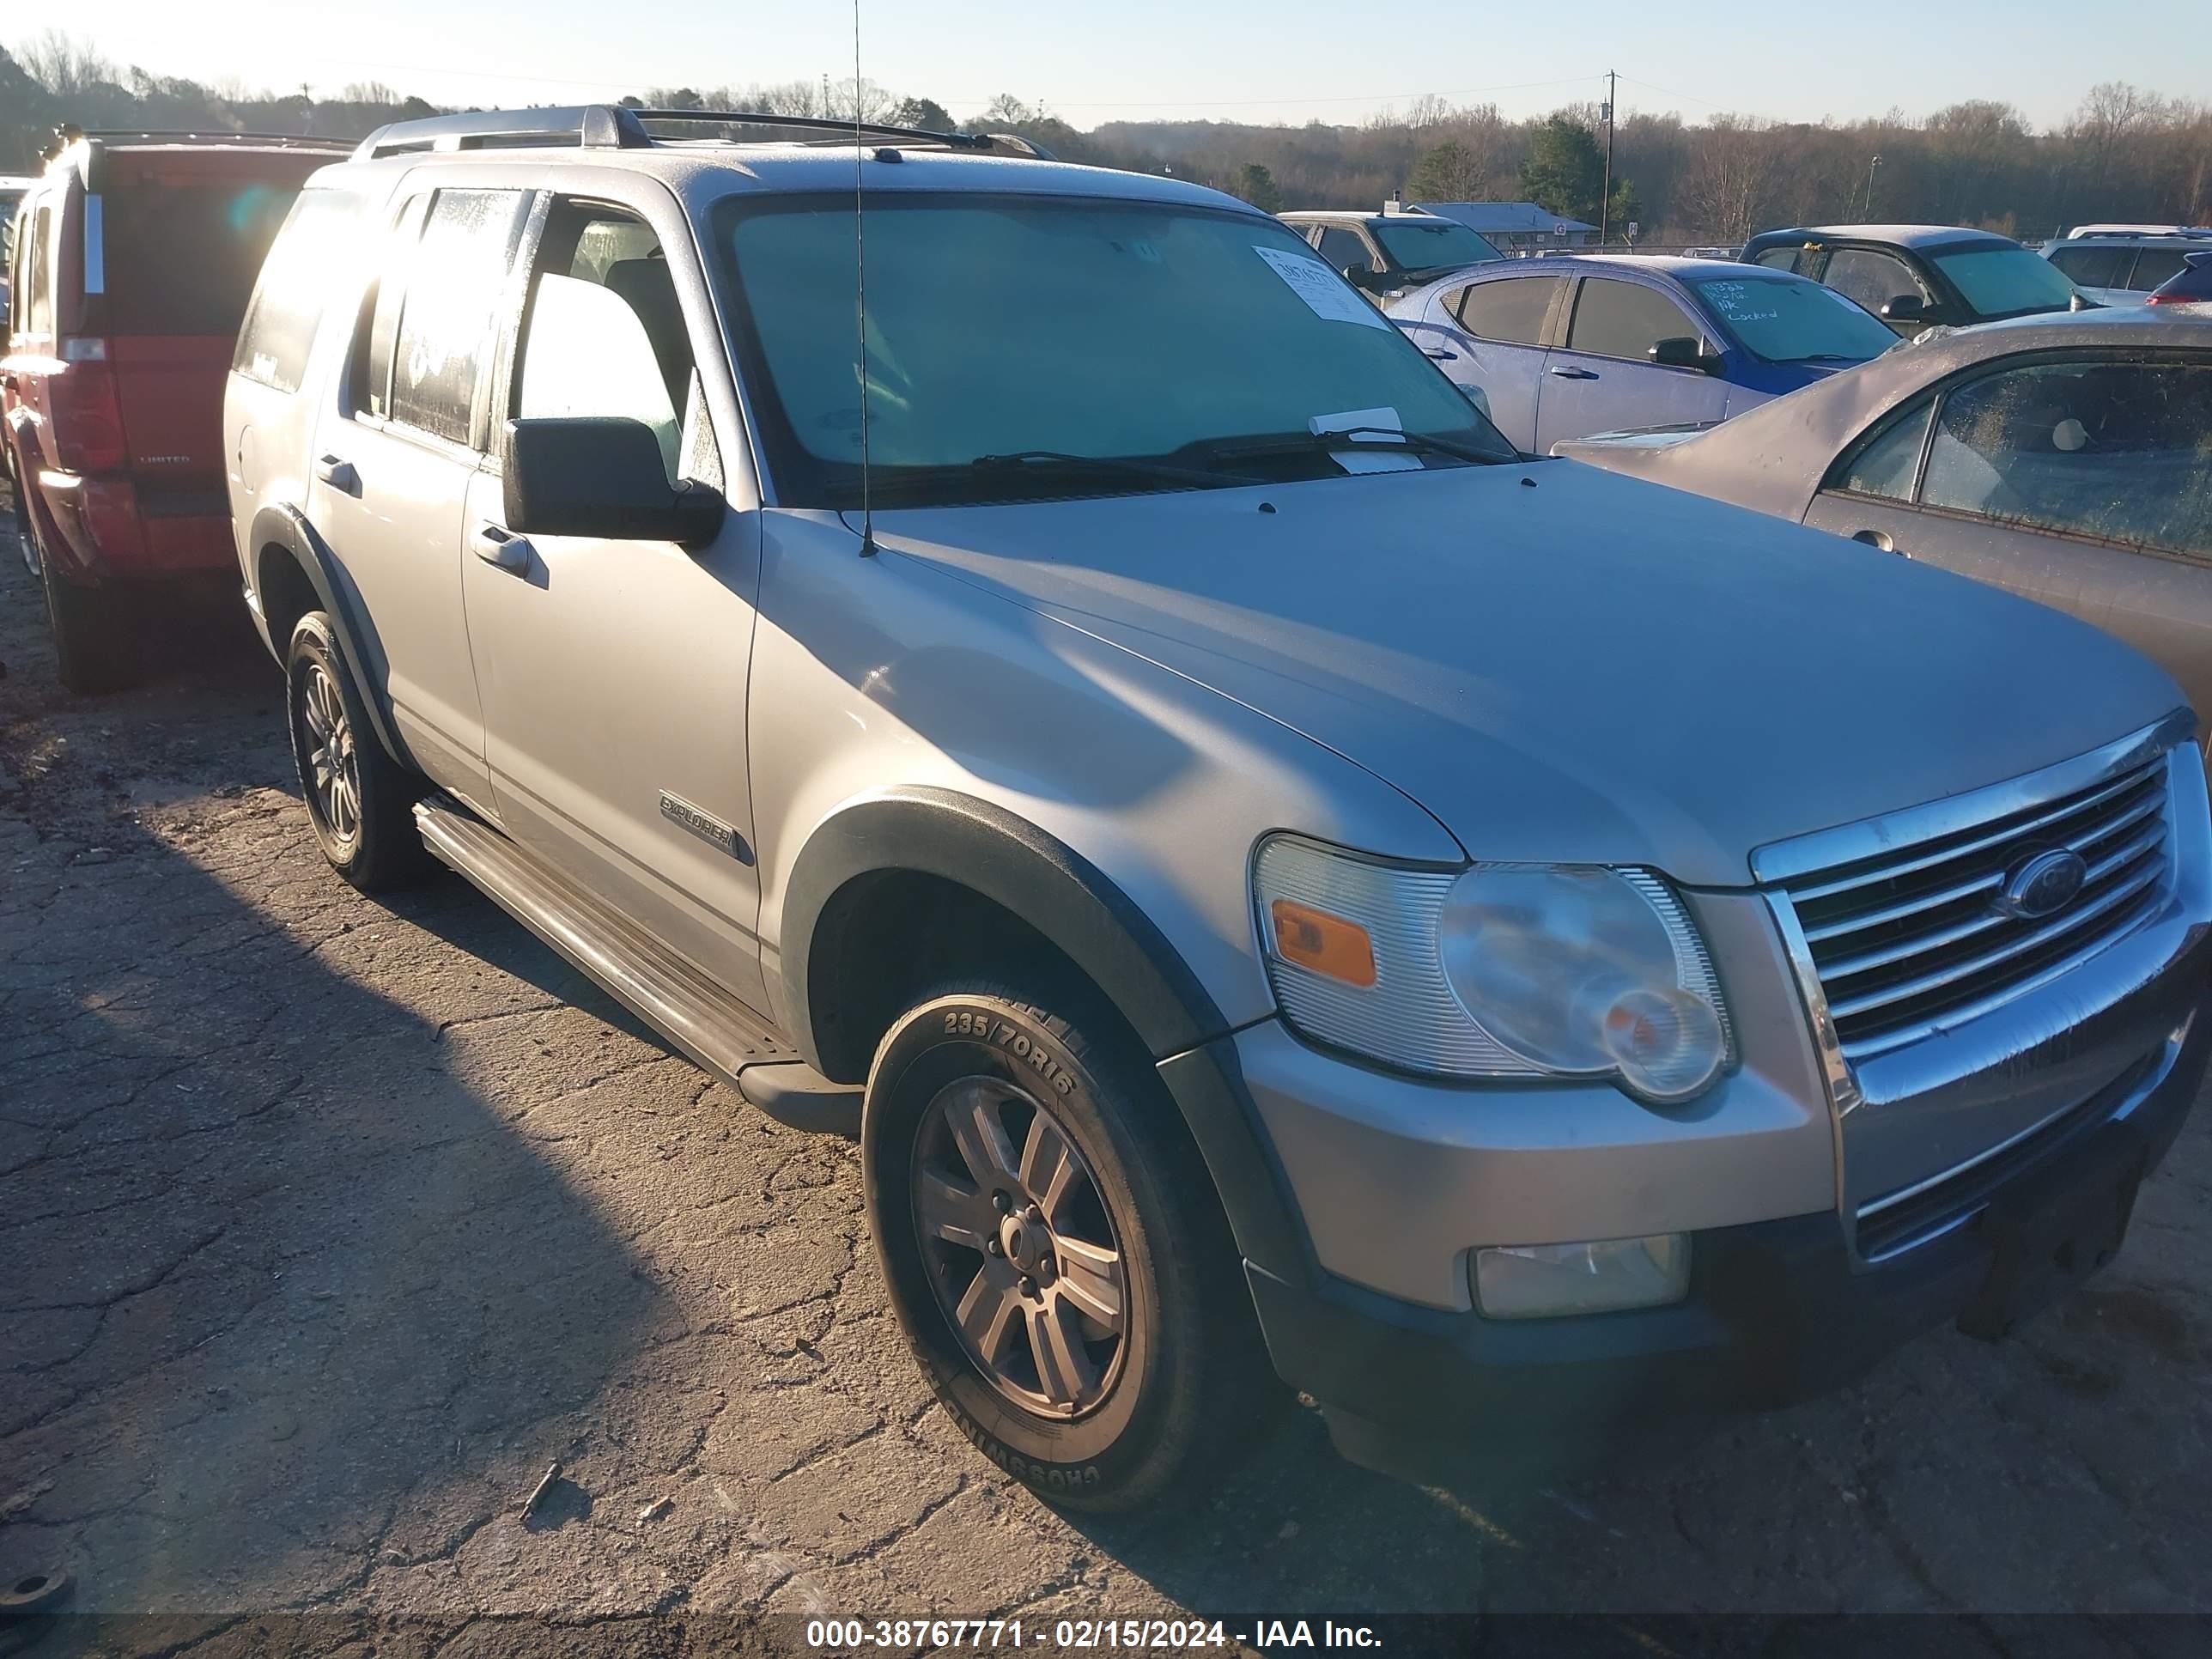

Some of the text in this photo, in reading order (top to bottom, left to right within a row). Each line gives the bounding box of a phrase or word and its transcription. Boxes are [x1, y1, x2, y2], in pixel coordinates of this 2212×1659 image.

[1556, 224, 1565, 234] G
[1629, 222, 1638, 234] H
[659, 795, 732, 847] EXPLORER
[944, 1012, 1079, 1097] 235/70R16
